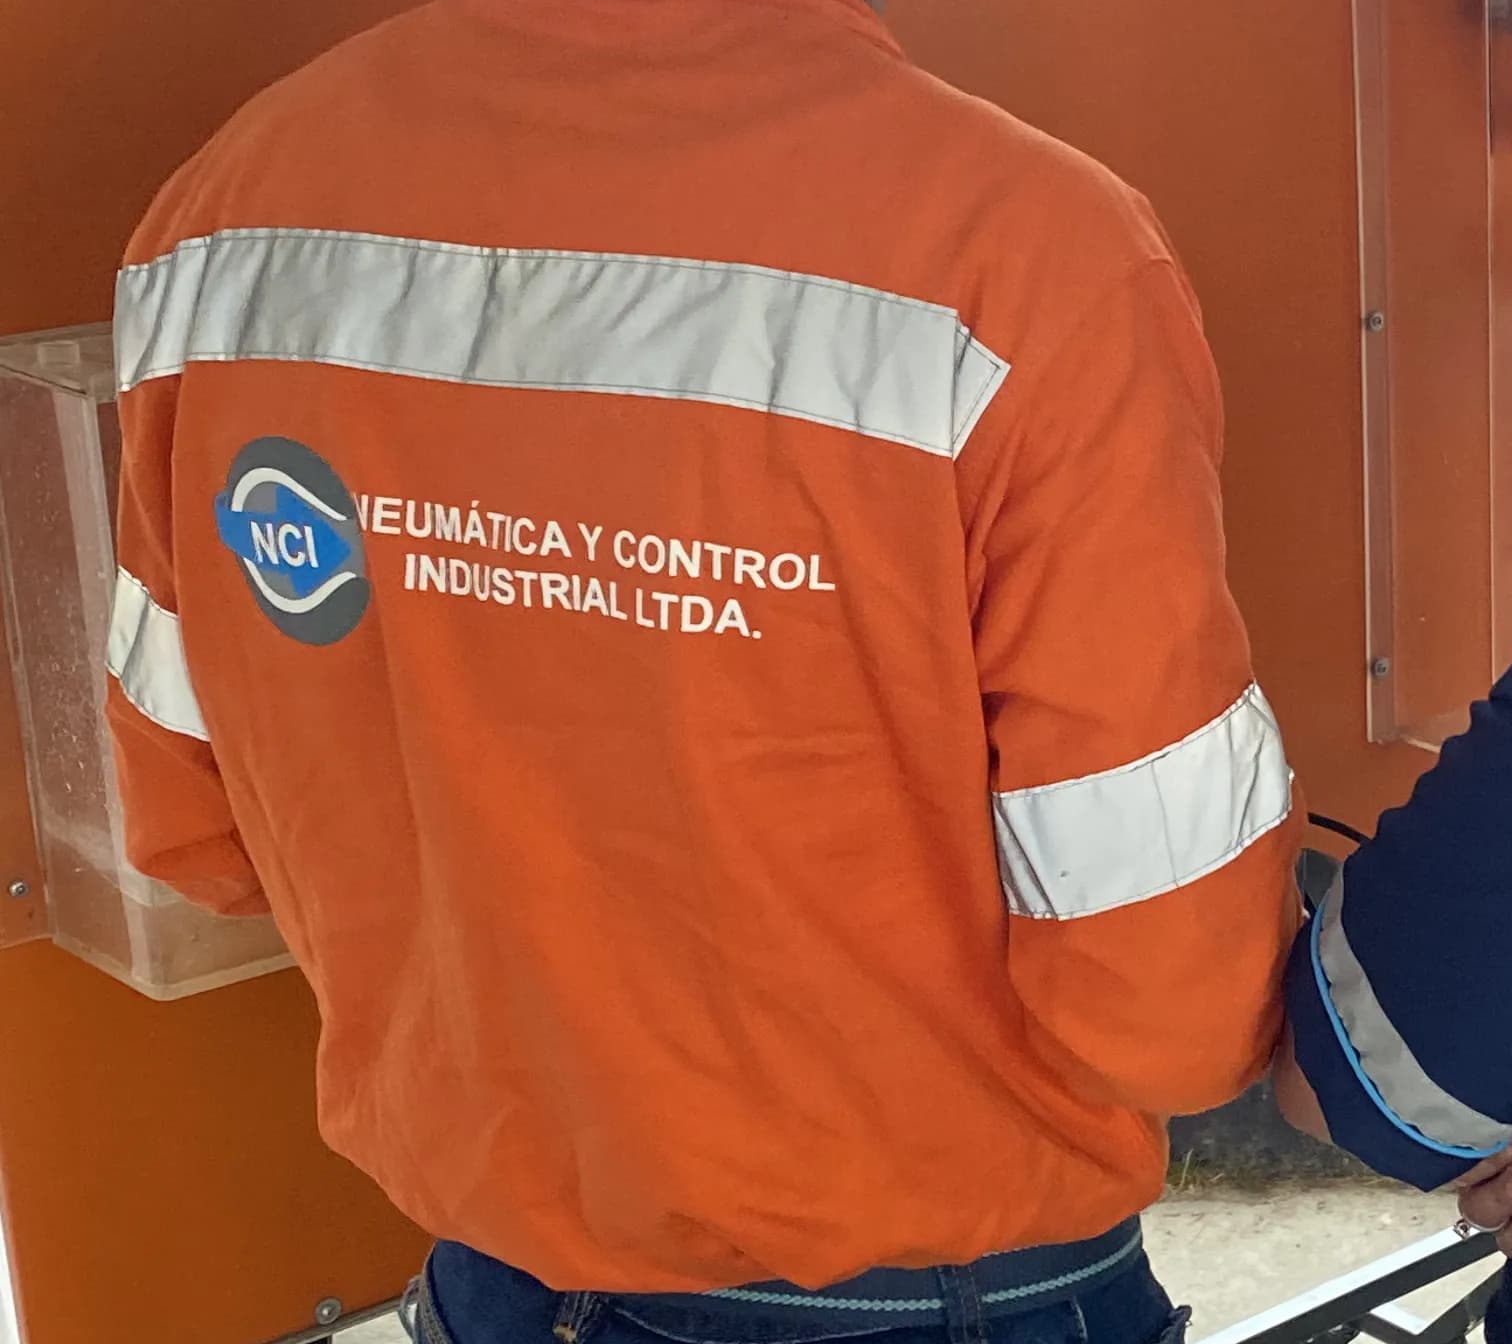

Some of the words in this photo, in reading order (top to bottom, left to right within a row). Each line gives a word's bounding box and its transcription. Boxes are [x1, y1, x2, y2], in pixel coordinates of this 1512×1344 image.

[249, 520, 319, 569] NCI
[579, 523, 603, 559] Y
[614, 529, 836, 592] CONTROL
[403, 553, 628, 621] INDUSTRIAL
[635, 588, 763, 639] LTDA.
